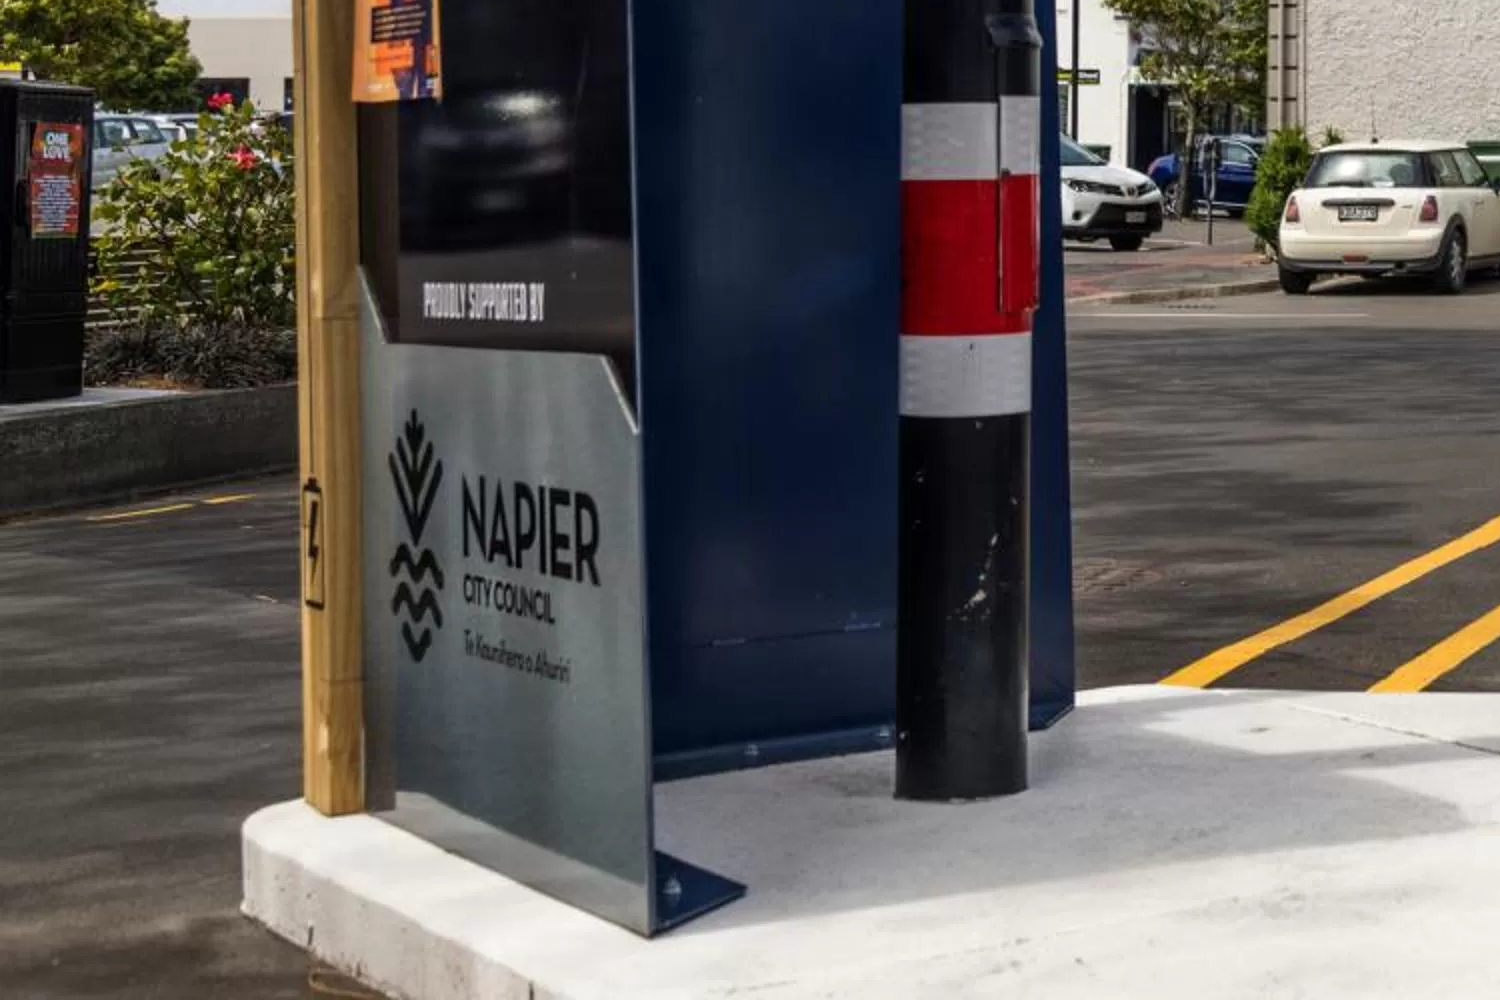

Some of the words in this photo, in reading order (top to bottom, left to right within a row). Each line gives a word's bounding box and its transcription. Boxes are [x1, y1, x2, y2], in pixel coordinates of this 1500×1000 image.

[423, 282, 467, 318] PROUDLY
[468, 282, 527, 320] SUPPORTED
[529, 282, 545, 321] BY
[462, 471, 601, 586] NAPIER
[463, 573, 494, 607] CITY
[494, 579, 556, 625] COUNCIL
